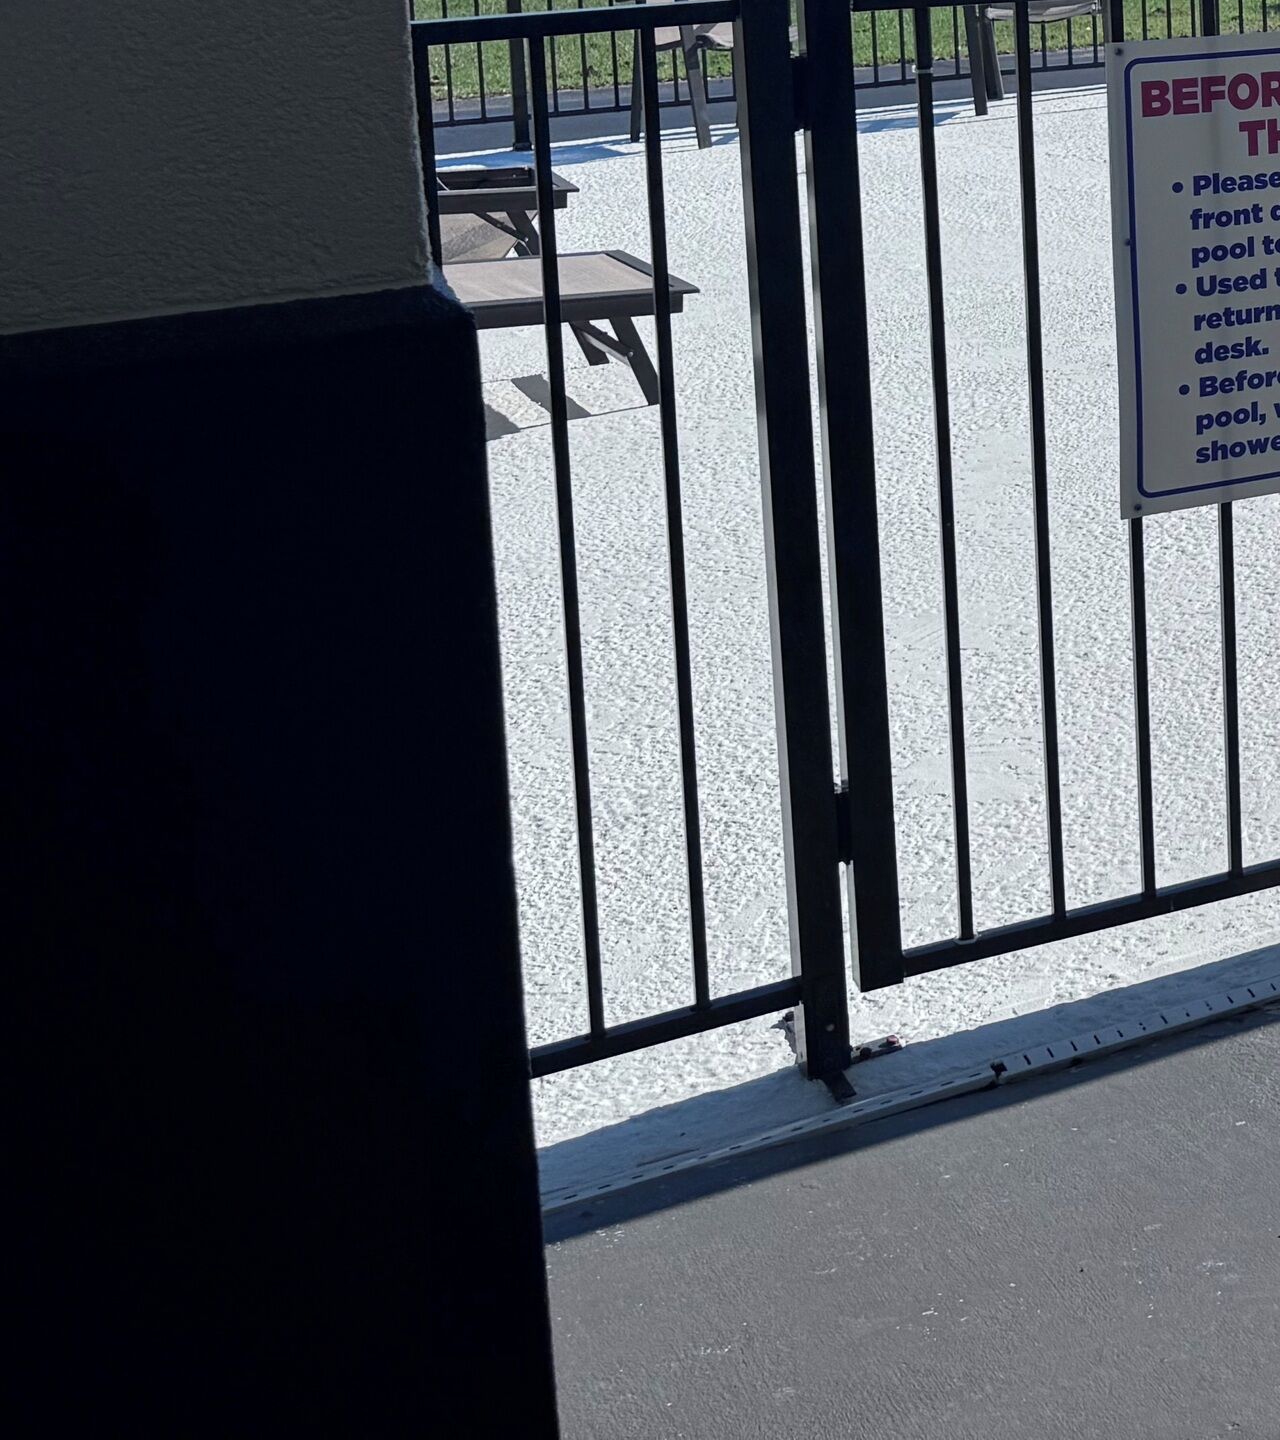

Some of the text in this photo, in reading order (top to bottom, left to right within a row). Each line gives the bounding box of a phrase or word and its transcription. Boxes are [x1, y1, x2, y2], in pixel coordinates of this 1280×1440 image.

[1190, 203, 1263, 230] front
[1191, 236, 1255, 269] pool
[1196, 268, 1268, 297] Used
[1194, 336, 1270, 365] desk.
[1195, 400, 1267, 435] pool,
